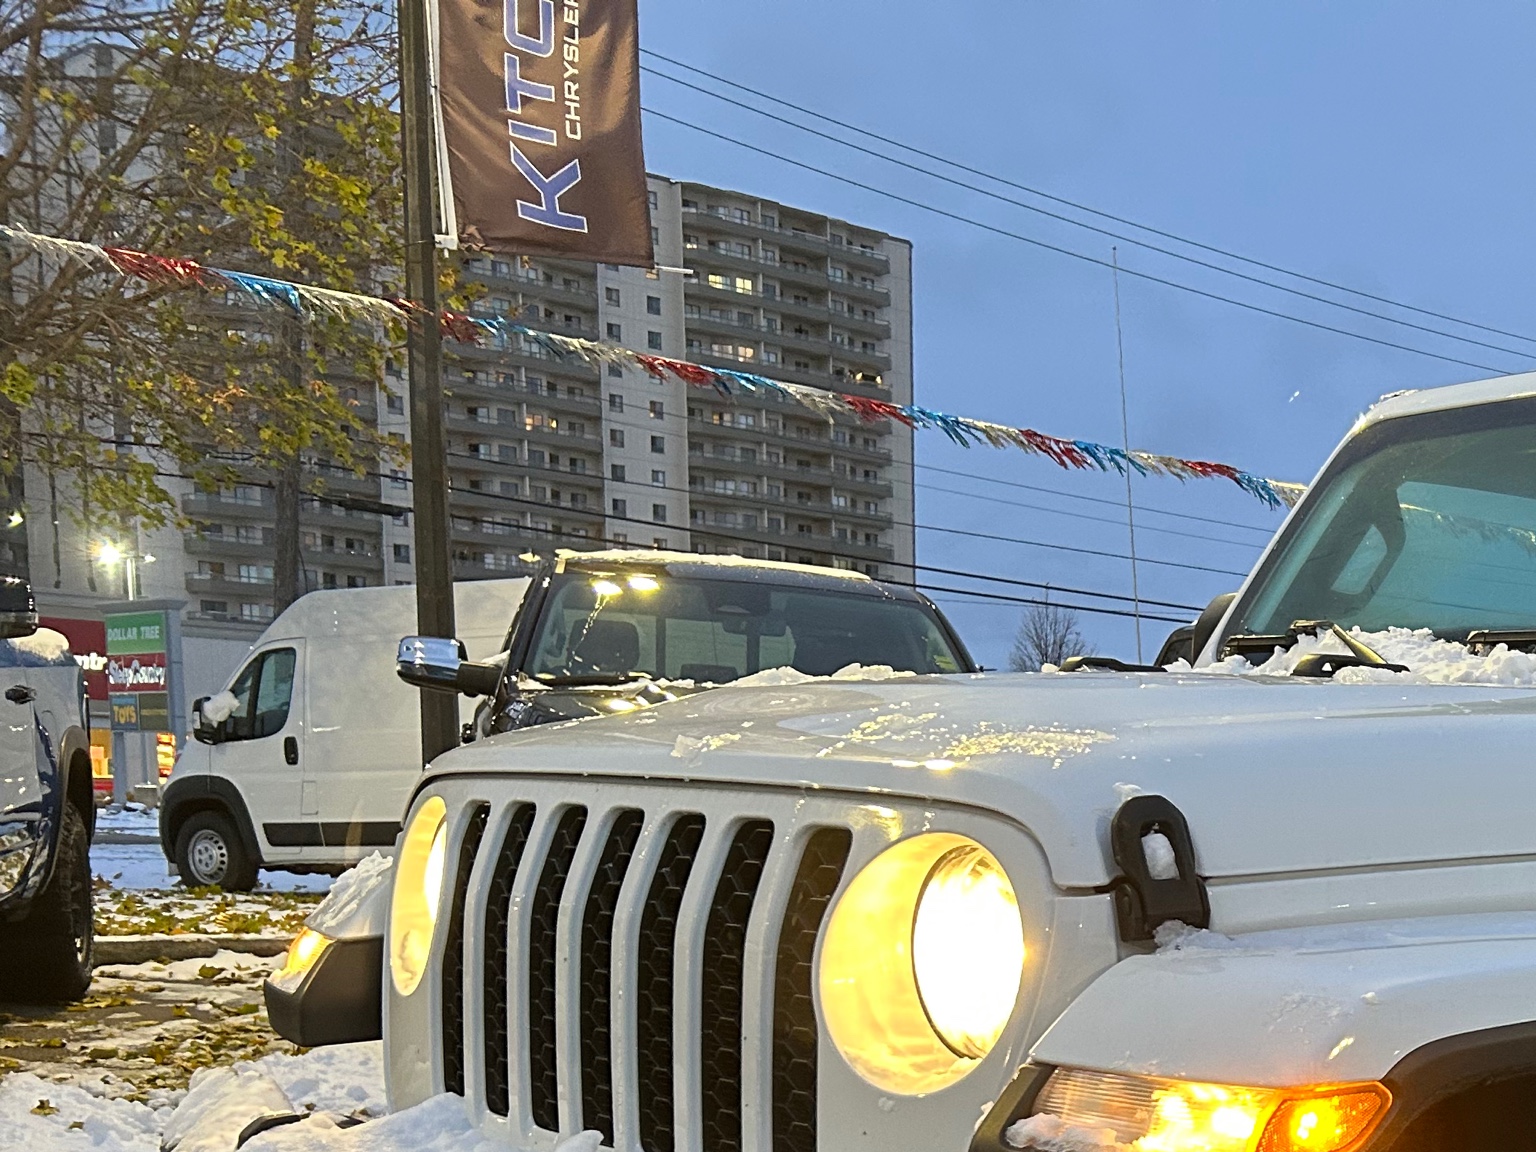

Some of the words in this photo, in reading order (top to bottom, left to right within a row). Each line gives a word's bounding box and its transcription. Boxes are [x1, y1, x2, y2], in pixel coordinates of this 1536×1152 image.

[107, 627, 138, 641] DOLLAR
[140, 625, 160, 639] TREE
[113, 705, 137, 724] TOYS
